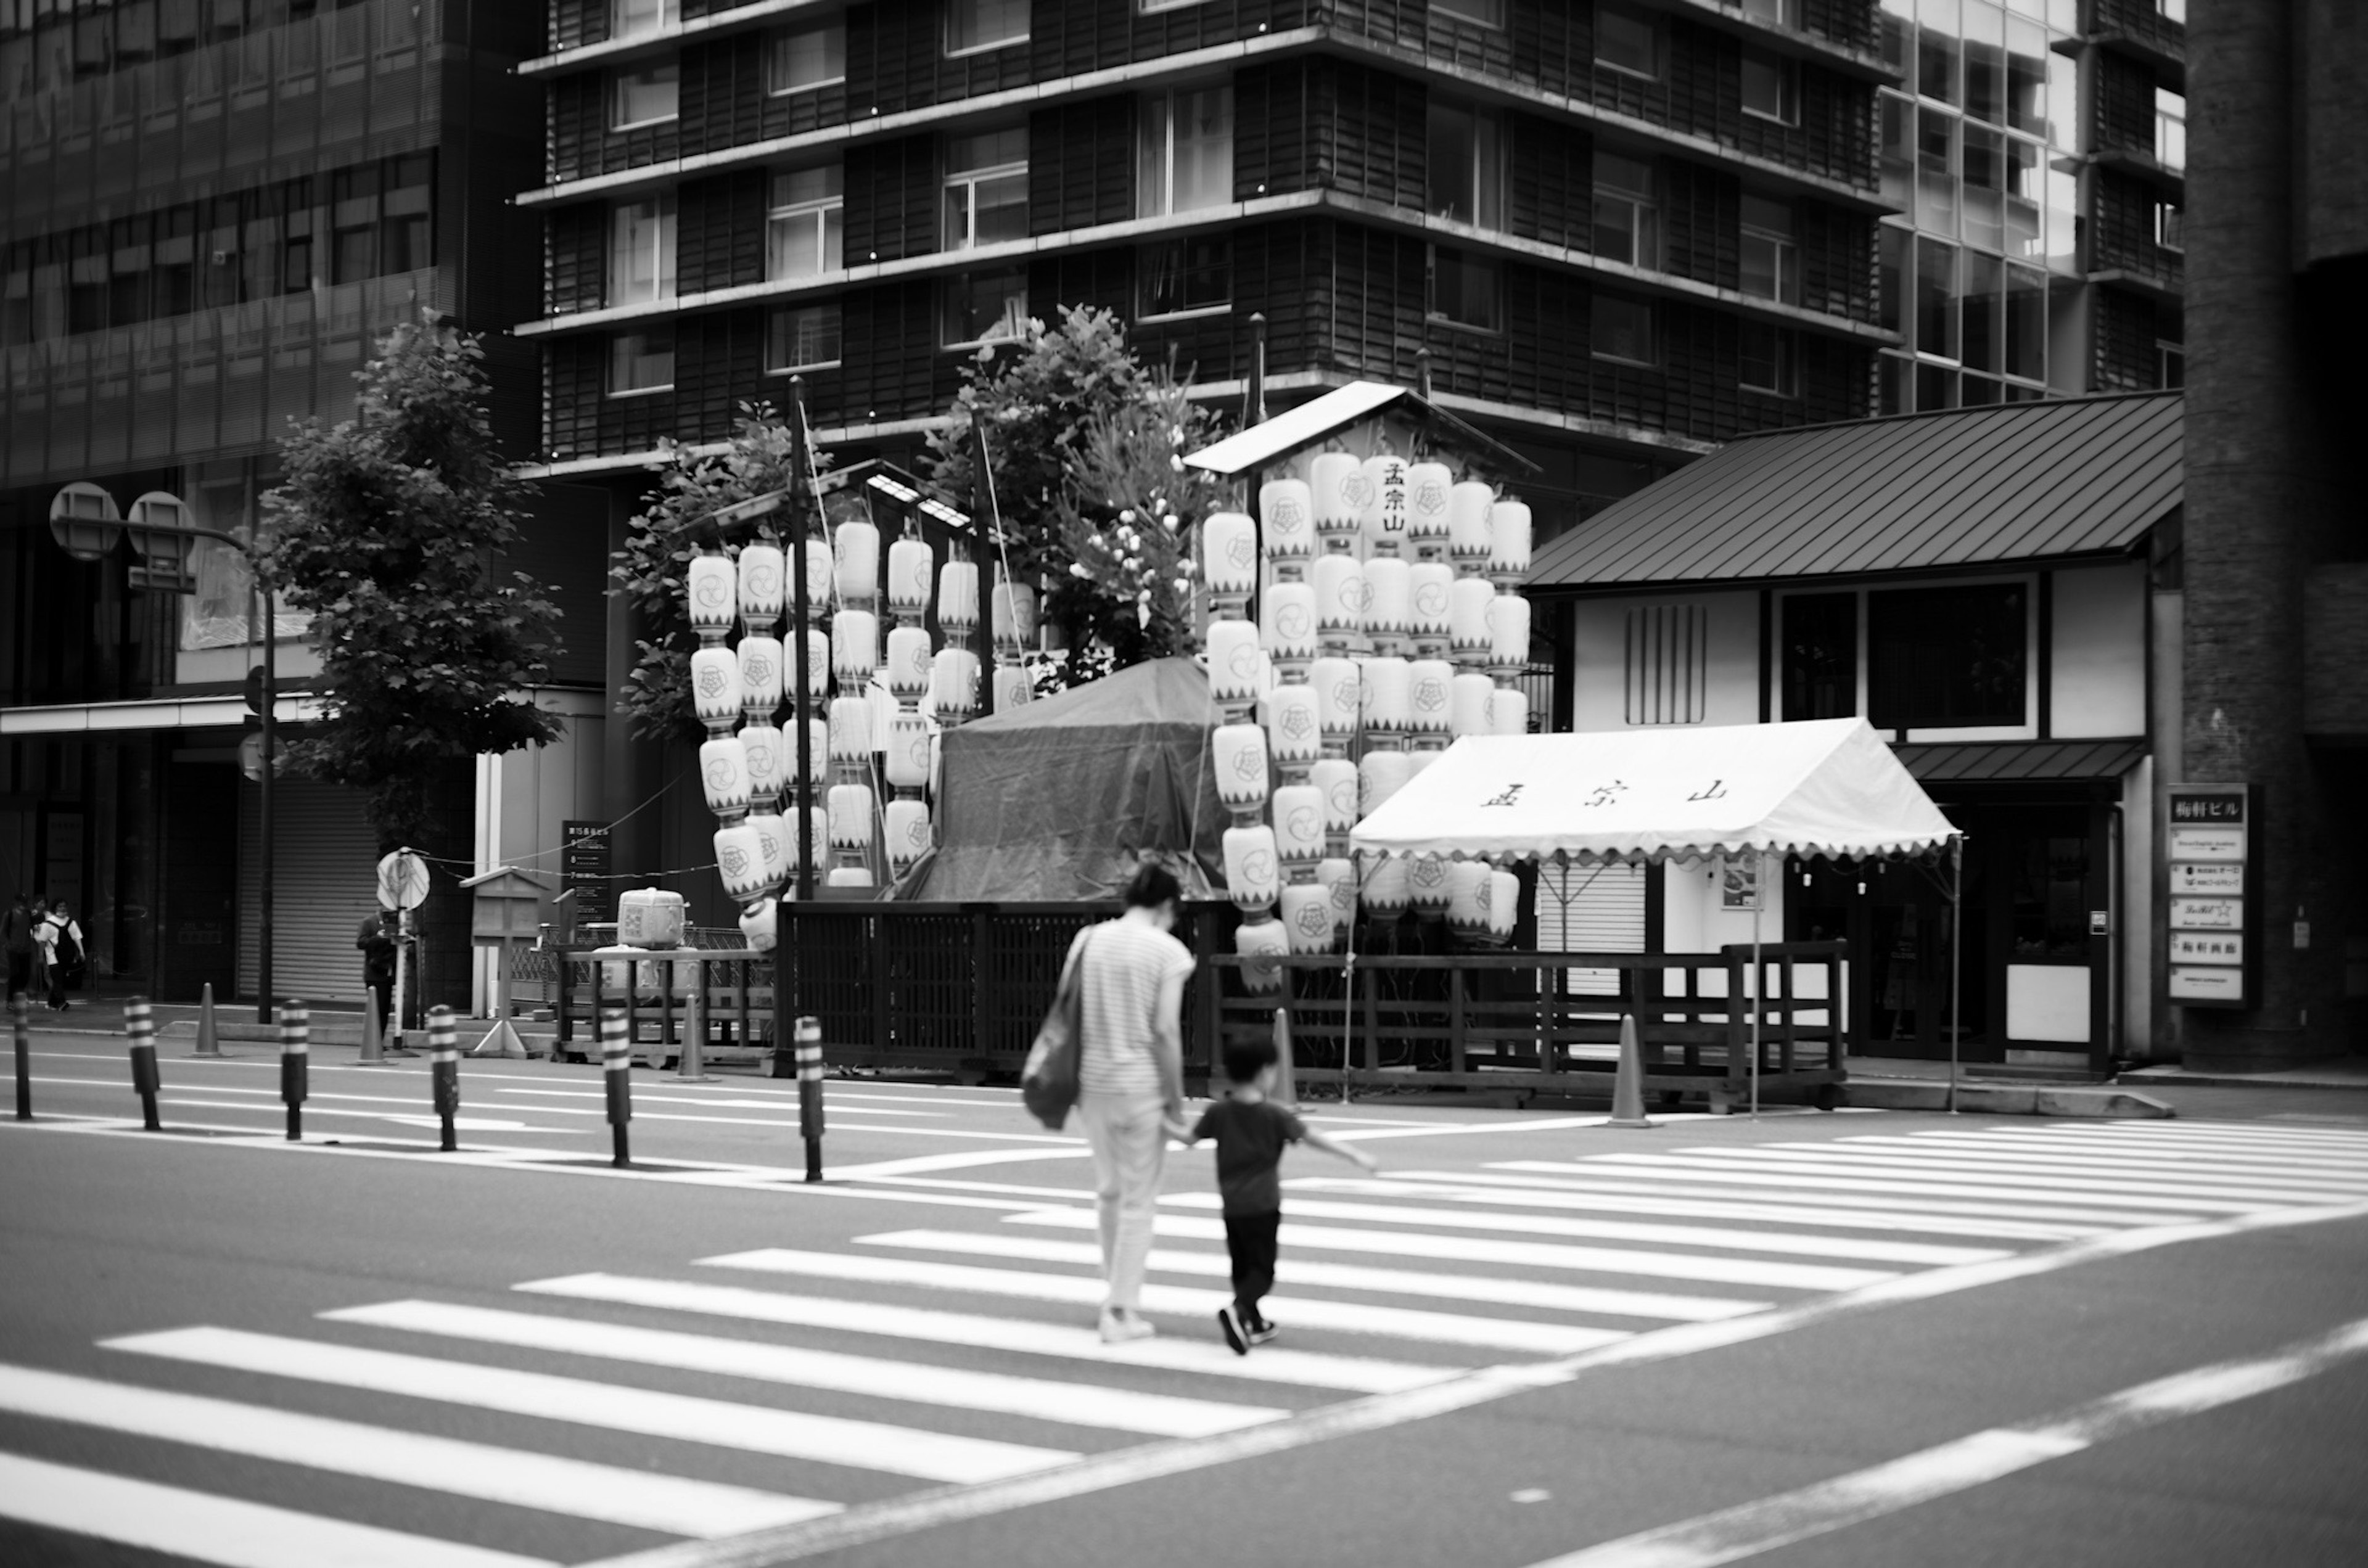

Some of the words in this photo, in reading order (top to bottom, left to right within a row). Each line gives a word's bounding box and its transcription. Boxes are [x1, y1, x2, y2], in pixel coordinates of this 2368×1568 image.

[1384, 463, 1405, 531] 孟宗山
[1480, 780, 1727, 807] 孟宗山
[2175, 801, 2240, 818] 梅軒ビル
